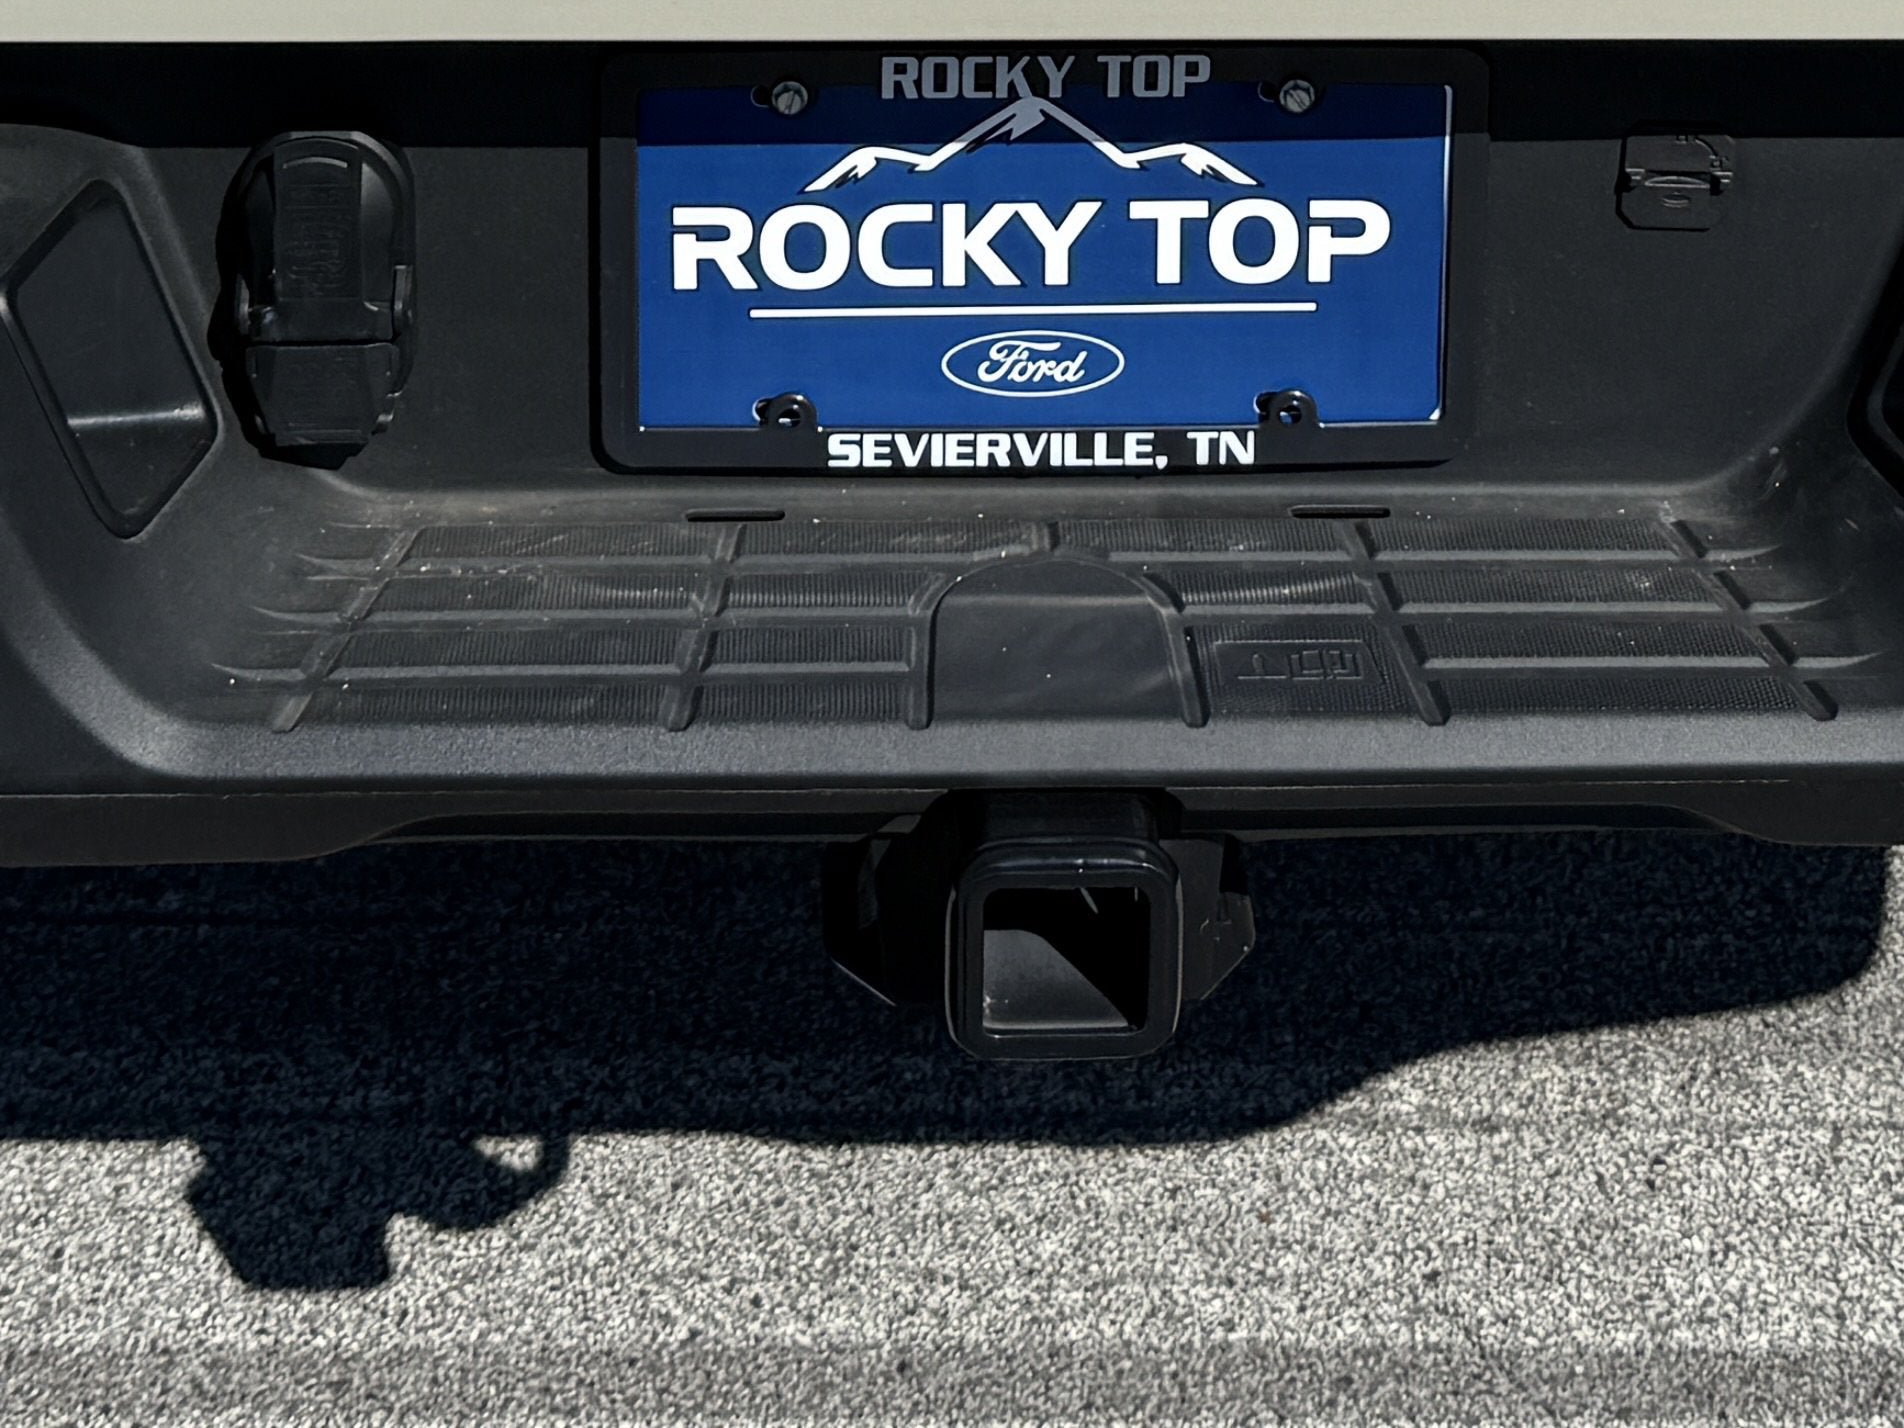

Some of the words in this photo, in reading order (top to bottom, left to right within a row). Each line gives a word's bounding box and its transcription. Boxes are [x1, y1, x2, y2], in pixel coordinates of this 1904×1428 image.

[881, 56, 1075, 99] ROCKY
[1097, 55, 1211, 97] TOP
[670, 200, 1103, 291] ROCKY
[1129, 198, 1391, 285] TOP
[977, 340, 1087, 383] Ford
[827, 432, 1168, 470] SEVIERVILLE,
[1187, 430, 1256, 465] TN
